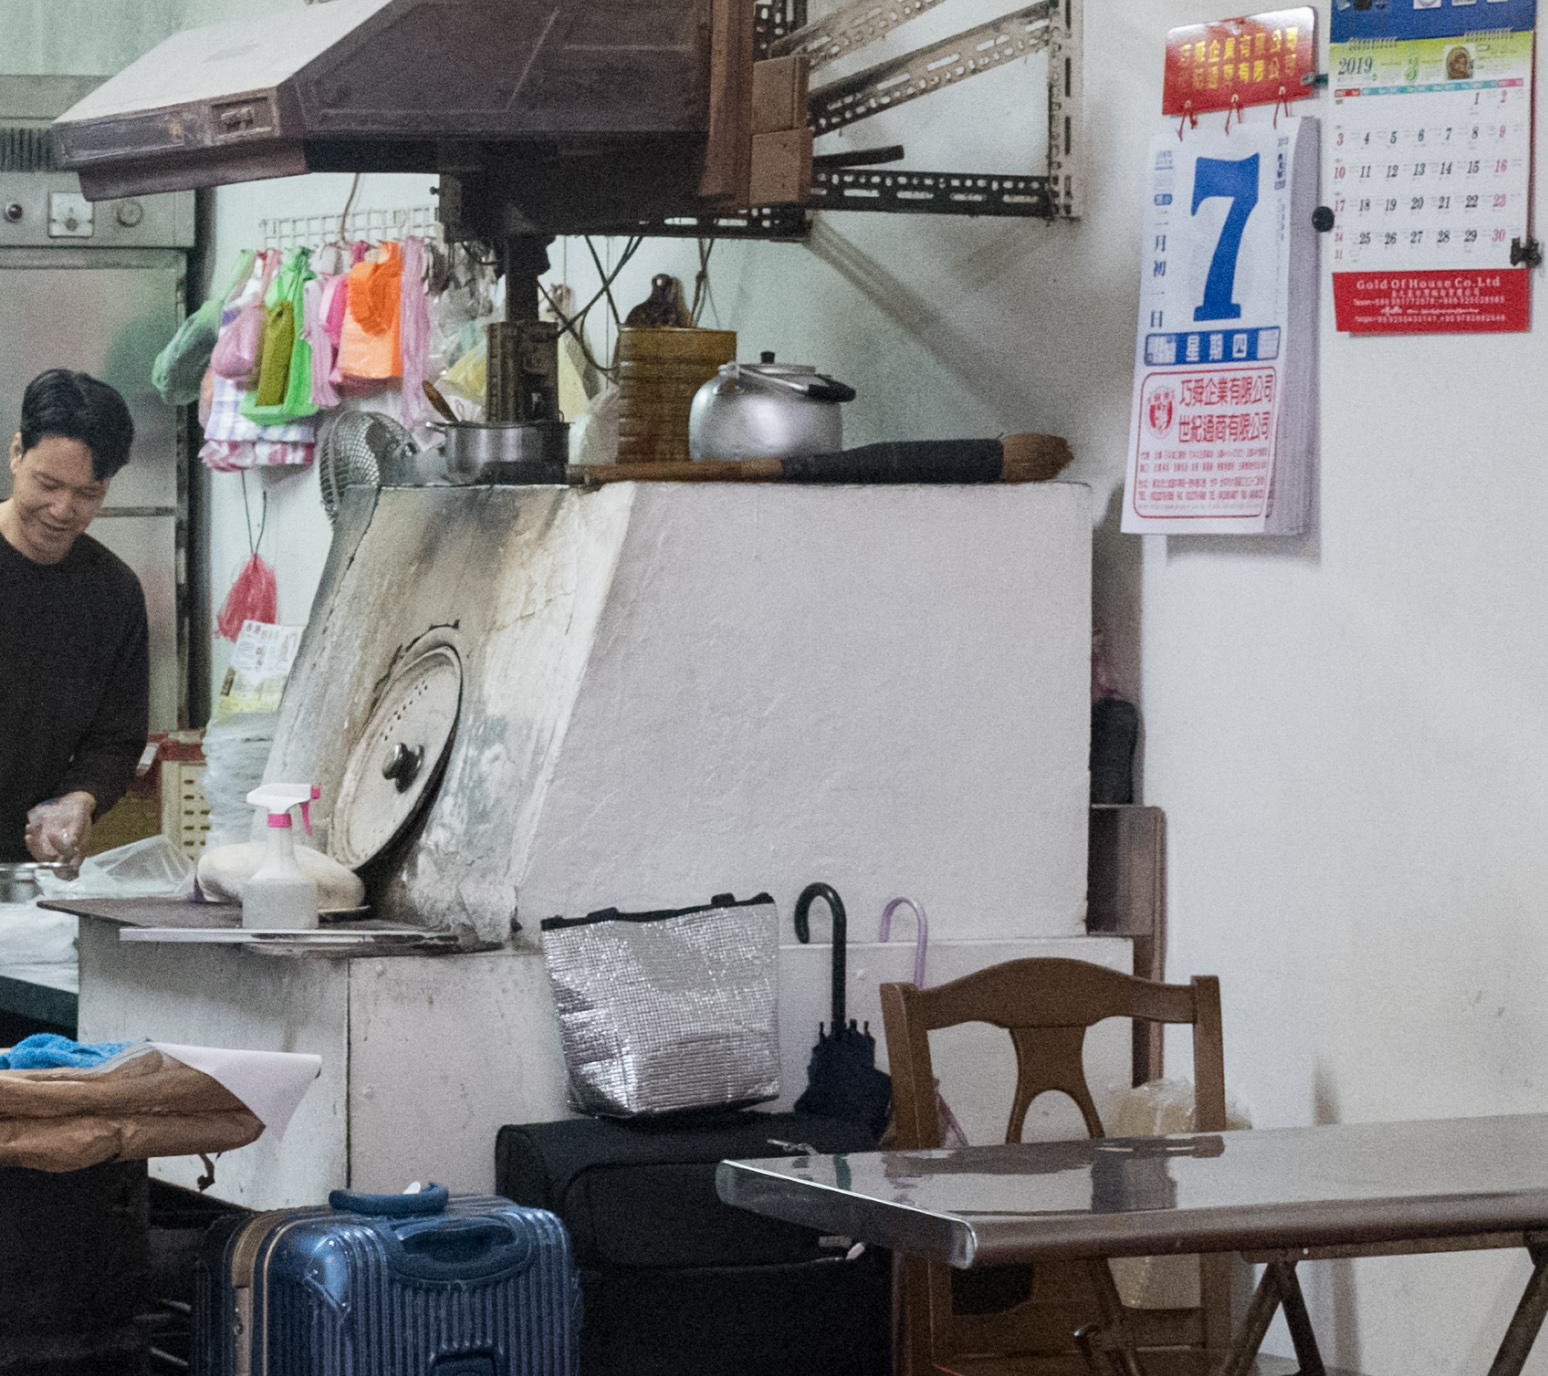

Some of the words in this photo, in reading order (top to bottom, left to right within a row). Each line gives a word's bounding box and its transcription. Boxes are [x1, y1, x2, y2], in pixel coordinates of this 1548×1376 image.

[1338, 57, 1373, 75] 2019
[1474, 92, 1480, 105] 1
[1500, 88, 1507, 103] 2
[1337, 133, 1344, 146] 3
[1364, 133, 1370, 144] 4
[1390, 131, 1397, 144] 5
[1418, 129, 1424, 141] 6
[1446, 127, 1452, 140] 7
[1473, 128, 1478, 138] 8
[1499, 125, 1506, 138] 9
[1335, 167, 1346, 179] 10
[1360, 166, 1371, 178] 11
[1387, 165, 1398, 178] 12
[1414, 163, 1426, 176] 13
[1440, 162, 1452, 175] 14
[1468, 160, 1479, 173] 15
[1495, 159, 1507, 172] 16
[1332, 199, 1345, 214] 17
[1360, 200, 1370, 211] 18
[1386, 199, 1397, 211] 19
[1411, 197, 1424, 210] 20
[1438, 196, 1450, 209] 21
[1465, 195, 1478, 208] 22
[1493, 194, 1506, 207] 23
[1191, 152, 1260, 322] 7
[1359, 232, 1371, 245] 25
[1385, 233, 1396, 245] 26
[1410, 230, 1423, 244] 27
[1437, 231, 1449, 243] 28
[1465, 230, 1477, 242] 29
[1493, 229, 1505, 241] 30
[1356, 279, 1387, 290] Gold
[1391, 278, 1406, 289] Of
[1409, 278, 1450, 288] House
[1185, 332, 1249, 362] 星期四
[1178, 411, 1271, 444] 世紀通商有限公司
